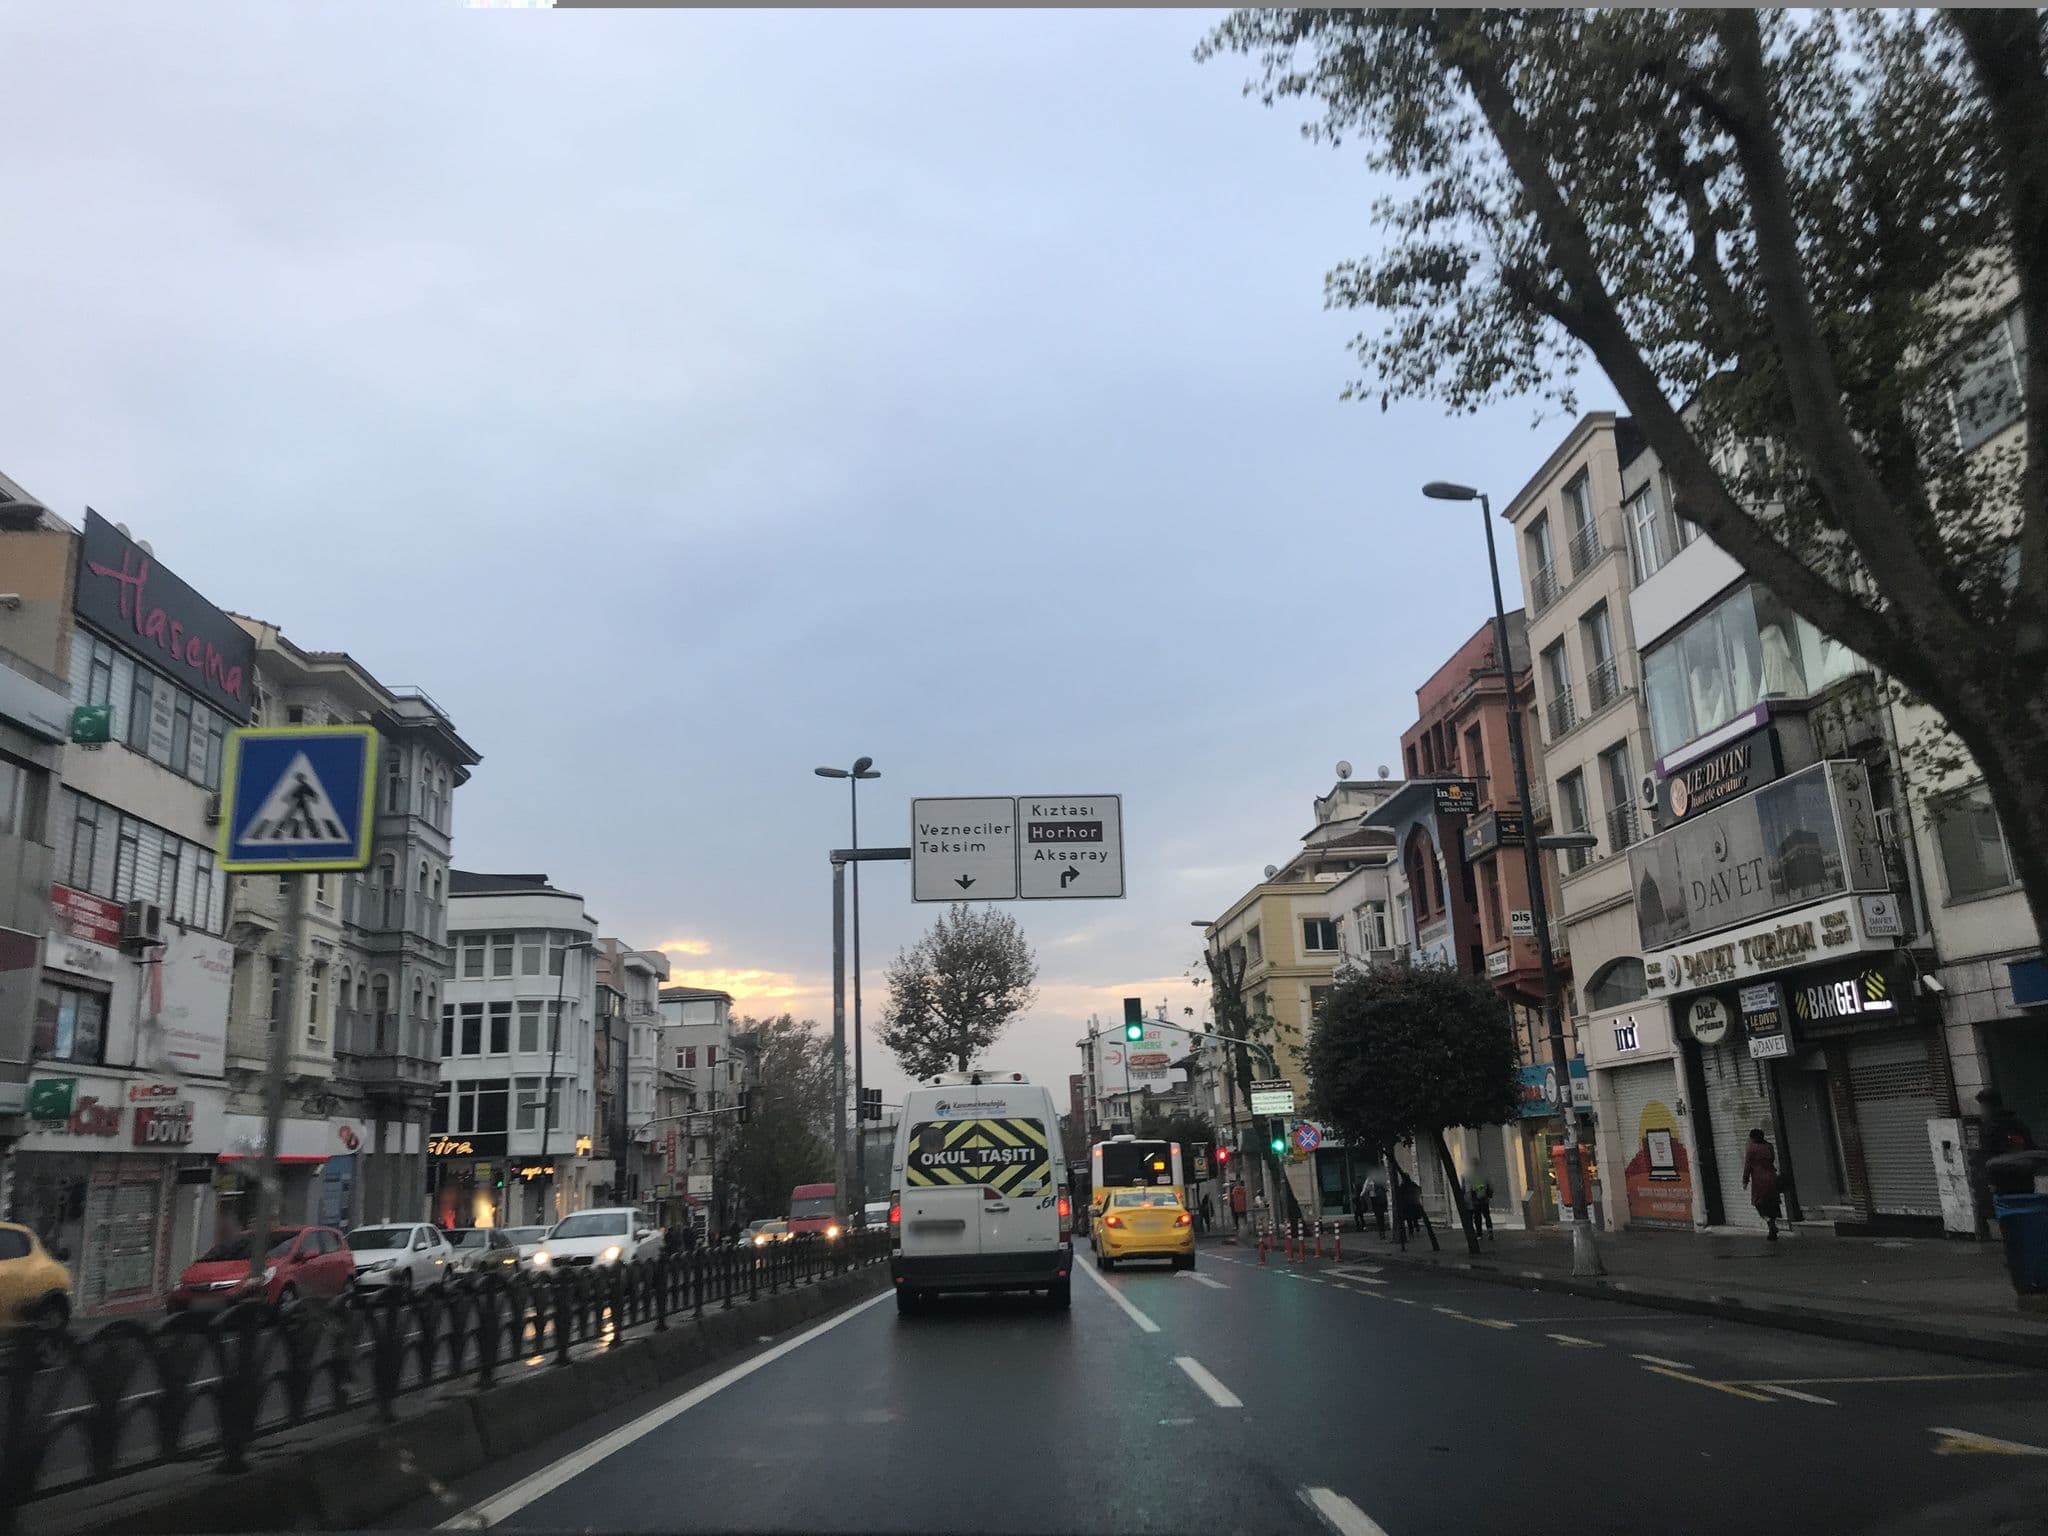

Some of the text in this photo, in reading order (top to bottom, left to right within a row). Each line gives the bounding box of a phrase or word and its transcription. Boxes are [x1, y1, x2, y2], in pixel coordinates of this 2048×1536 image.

[1032, 804, 1094, 817] Kıztaşı
[919, 822, 1011, 836] Vezneciler
[1032, 826, 1097, 839] Horhor
[919, 841, 986, 853] Taksim
[1033, 849, 1108, 863] Aksaray
[1692, 857, 1764, 911] DAVET
[920, 1148, 1035, 1165] OKUL TAŞITI
